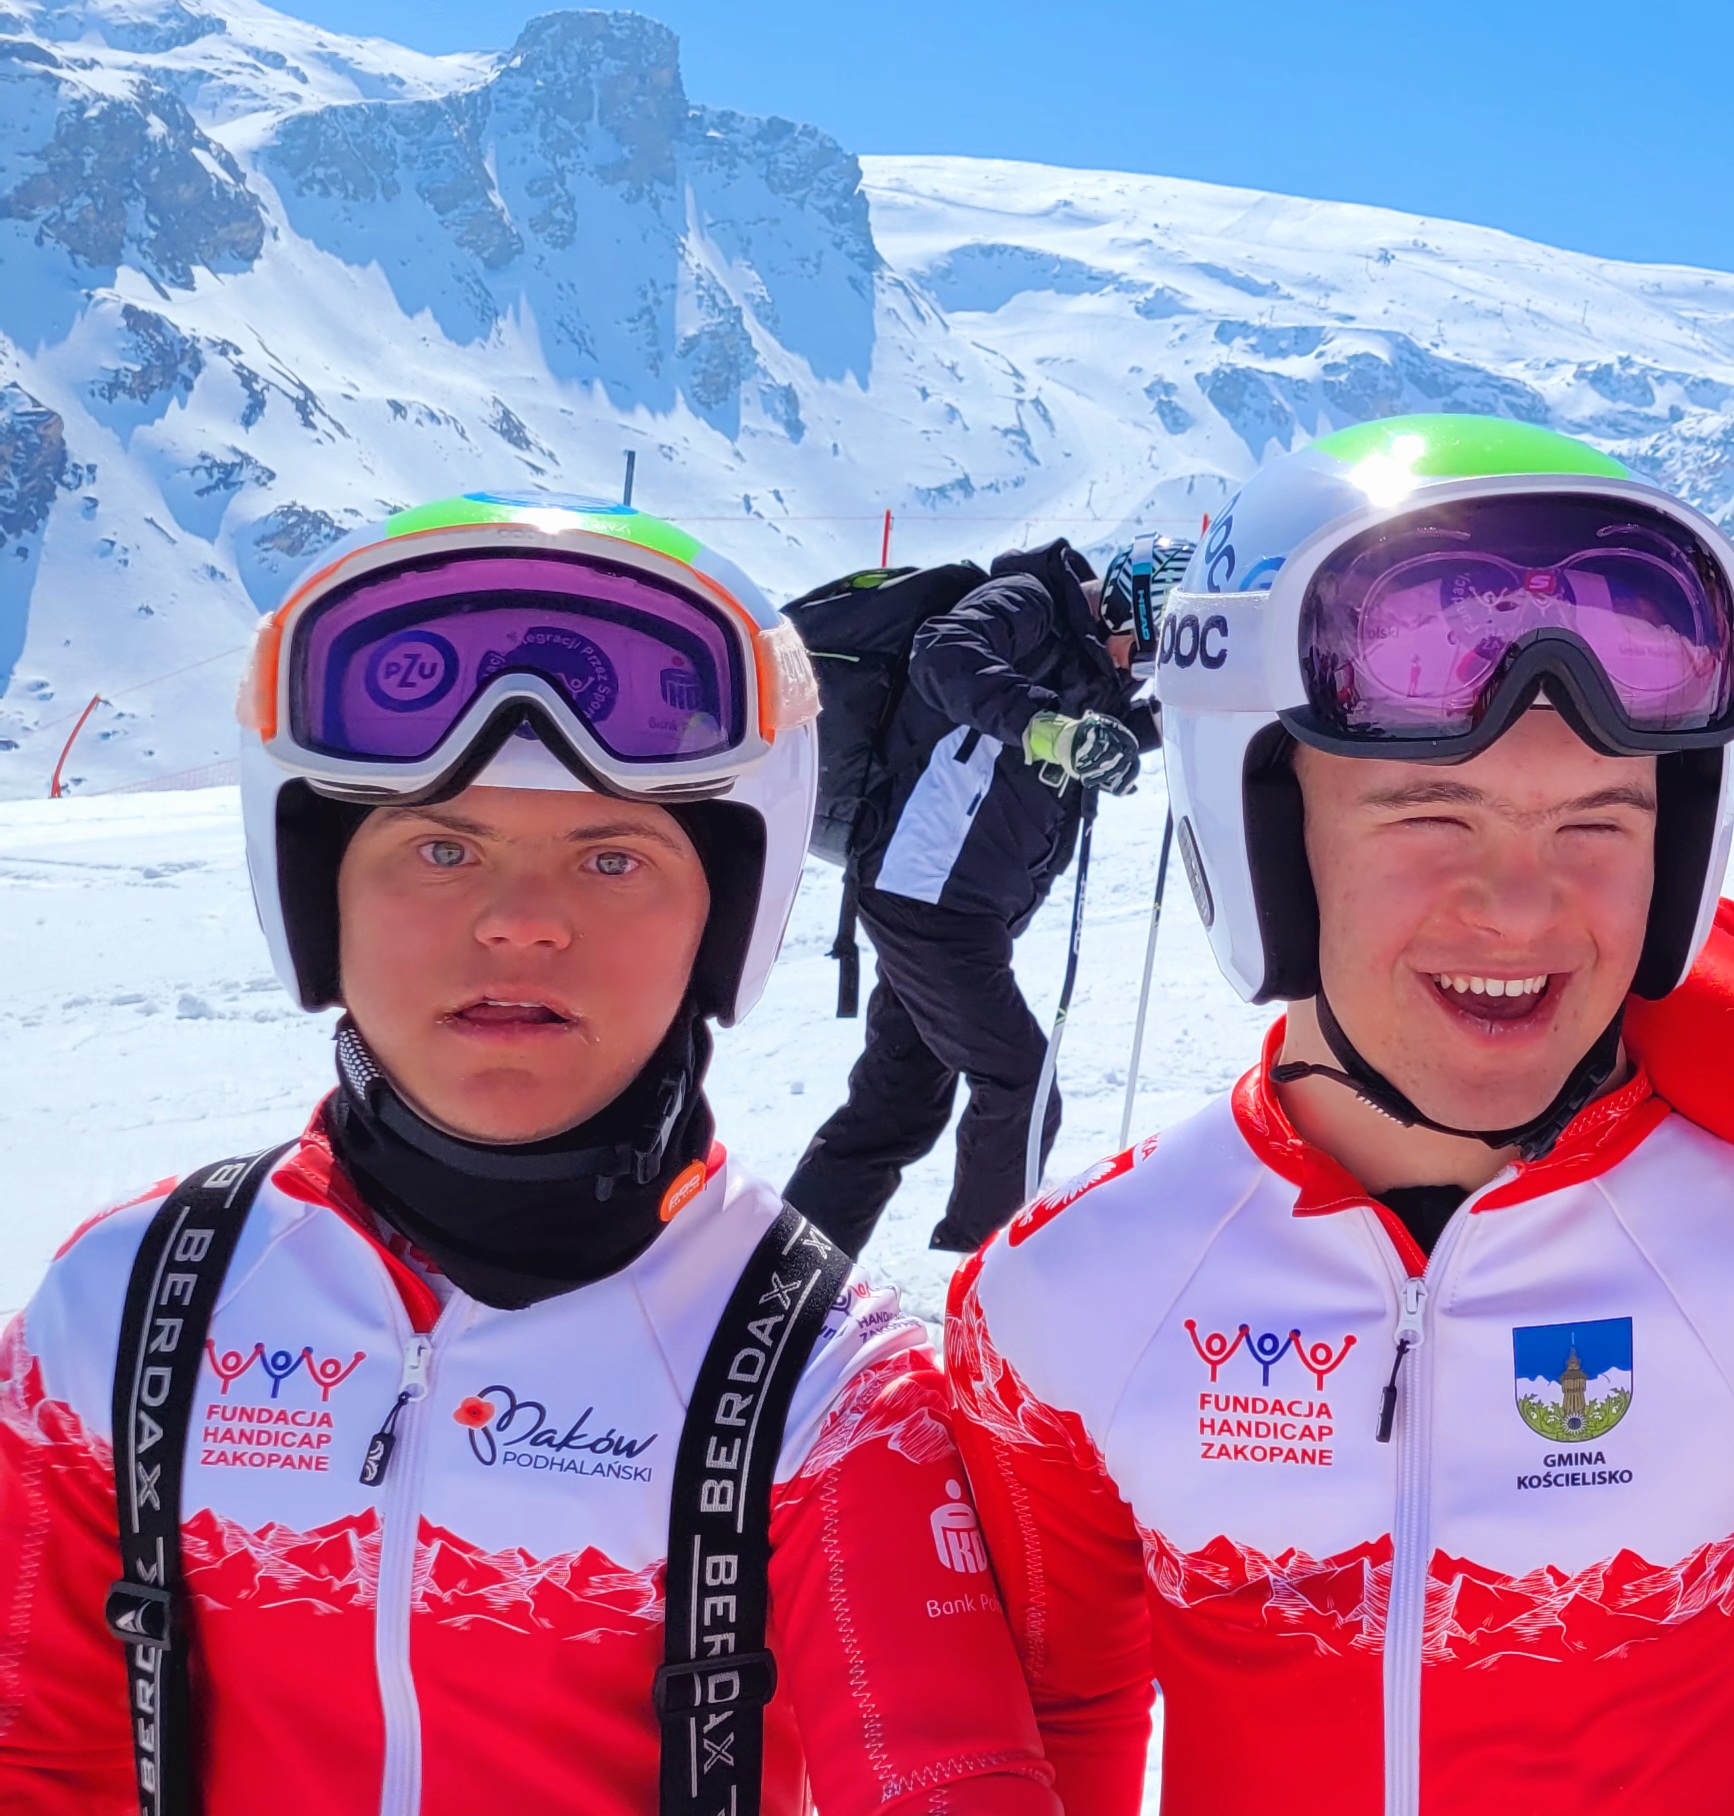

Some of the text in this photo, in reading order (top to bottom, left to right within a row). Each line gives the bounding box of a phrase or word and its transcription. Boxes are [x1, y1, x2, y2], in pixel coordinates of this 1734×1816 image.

[384, 653, 438, 689] PZU
[136, 1228, 215, 1512] BERDAX
[700, 1271, 802, 1513] BERDAX
[206, 1404, 334, 1429] FUNDACJA
[1199, 1393, 1333, 1420] FUNDACJA
[202, 1426, 332, 1450] HANDICAP
[1199, 1417, 1334, 1443] HANDICAP
[200, 1450, 330, 1472] ZAKOPANE
[502, 1451, 653, 1483] PODHALAŃSKI
[1200, 1442, 1333, 1467] ZAKOPANE
[1543, 1451, 1606, 1468] GMINA
[1516, 1469, 1633, 1490] KOŚCIELISKO
[926, 1593, 976, 1619] Bank
